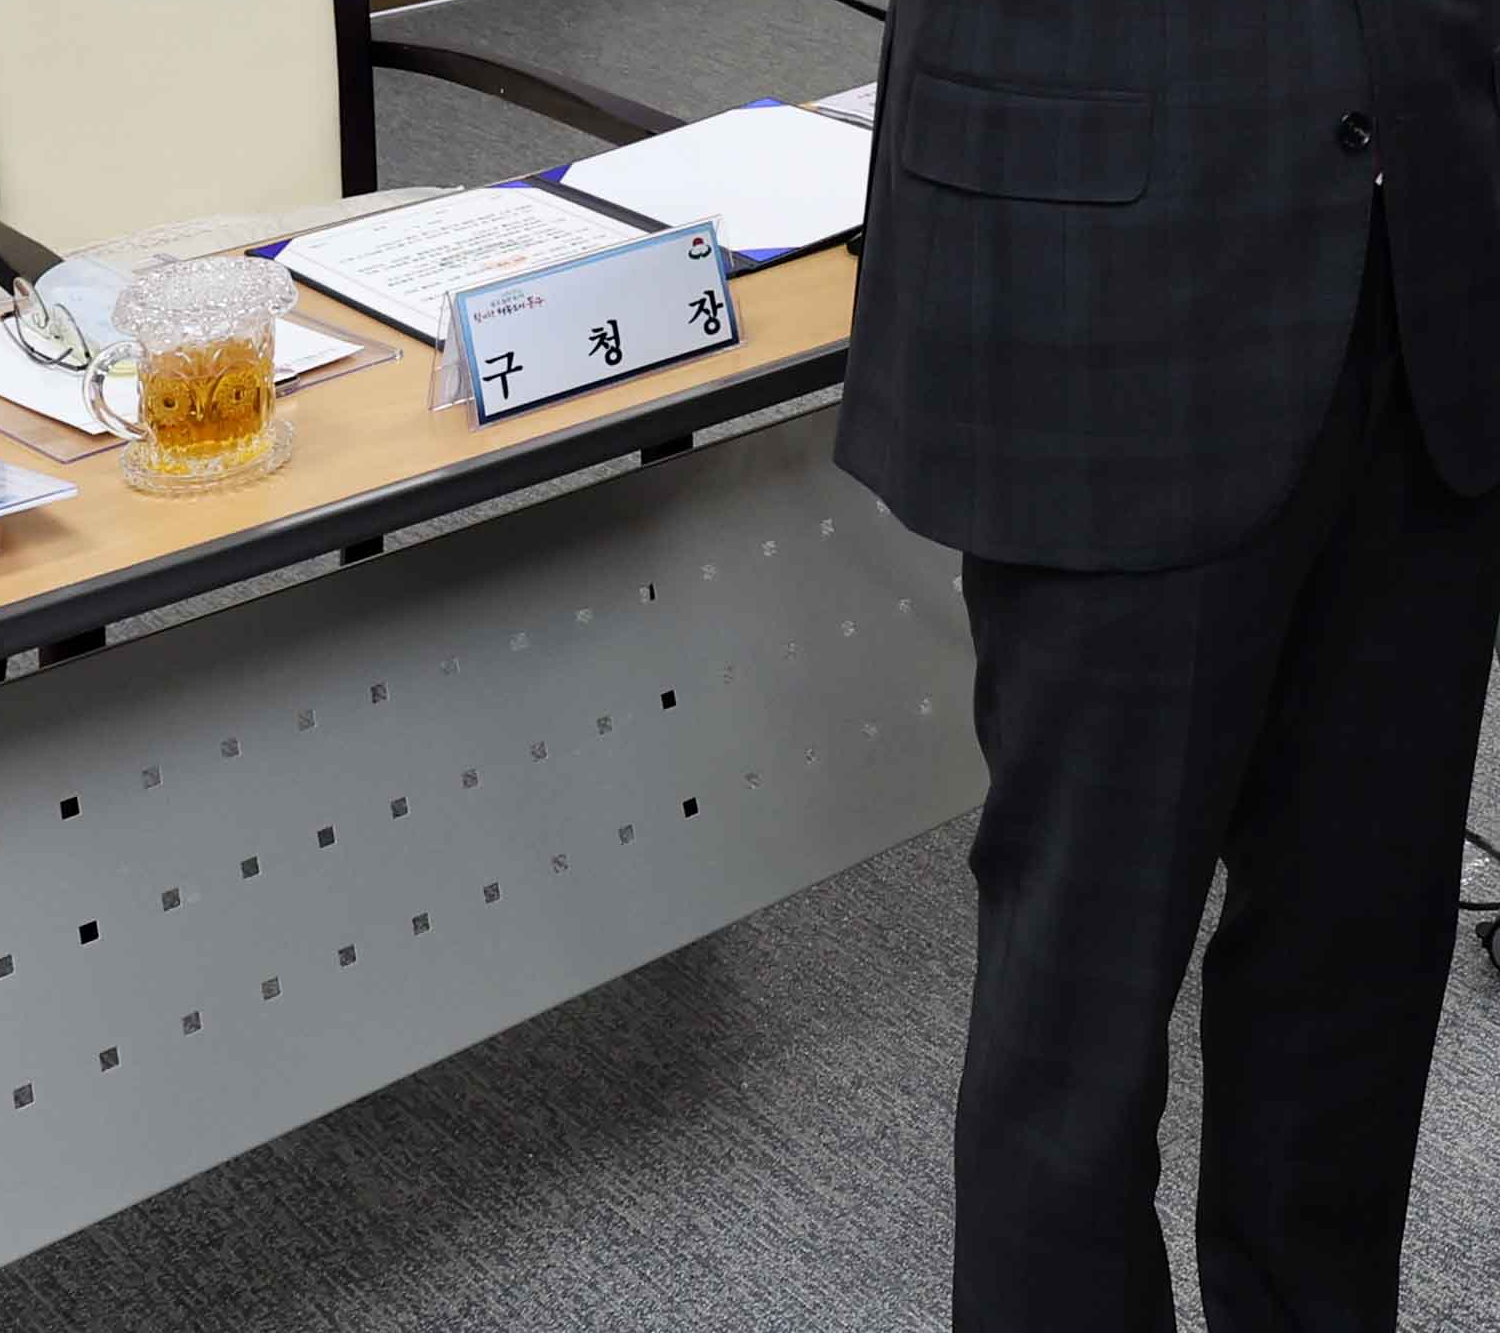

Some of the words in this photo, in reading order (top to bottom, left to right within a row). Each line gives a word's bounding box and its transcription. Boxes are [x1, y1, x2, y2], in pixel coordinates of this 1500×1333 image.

[482, 351, 524, 400] 구
[588, 319, 623, 366] 청
[688, 290, 724, 335] 장
